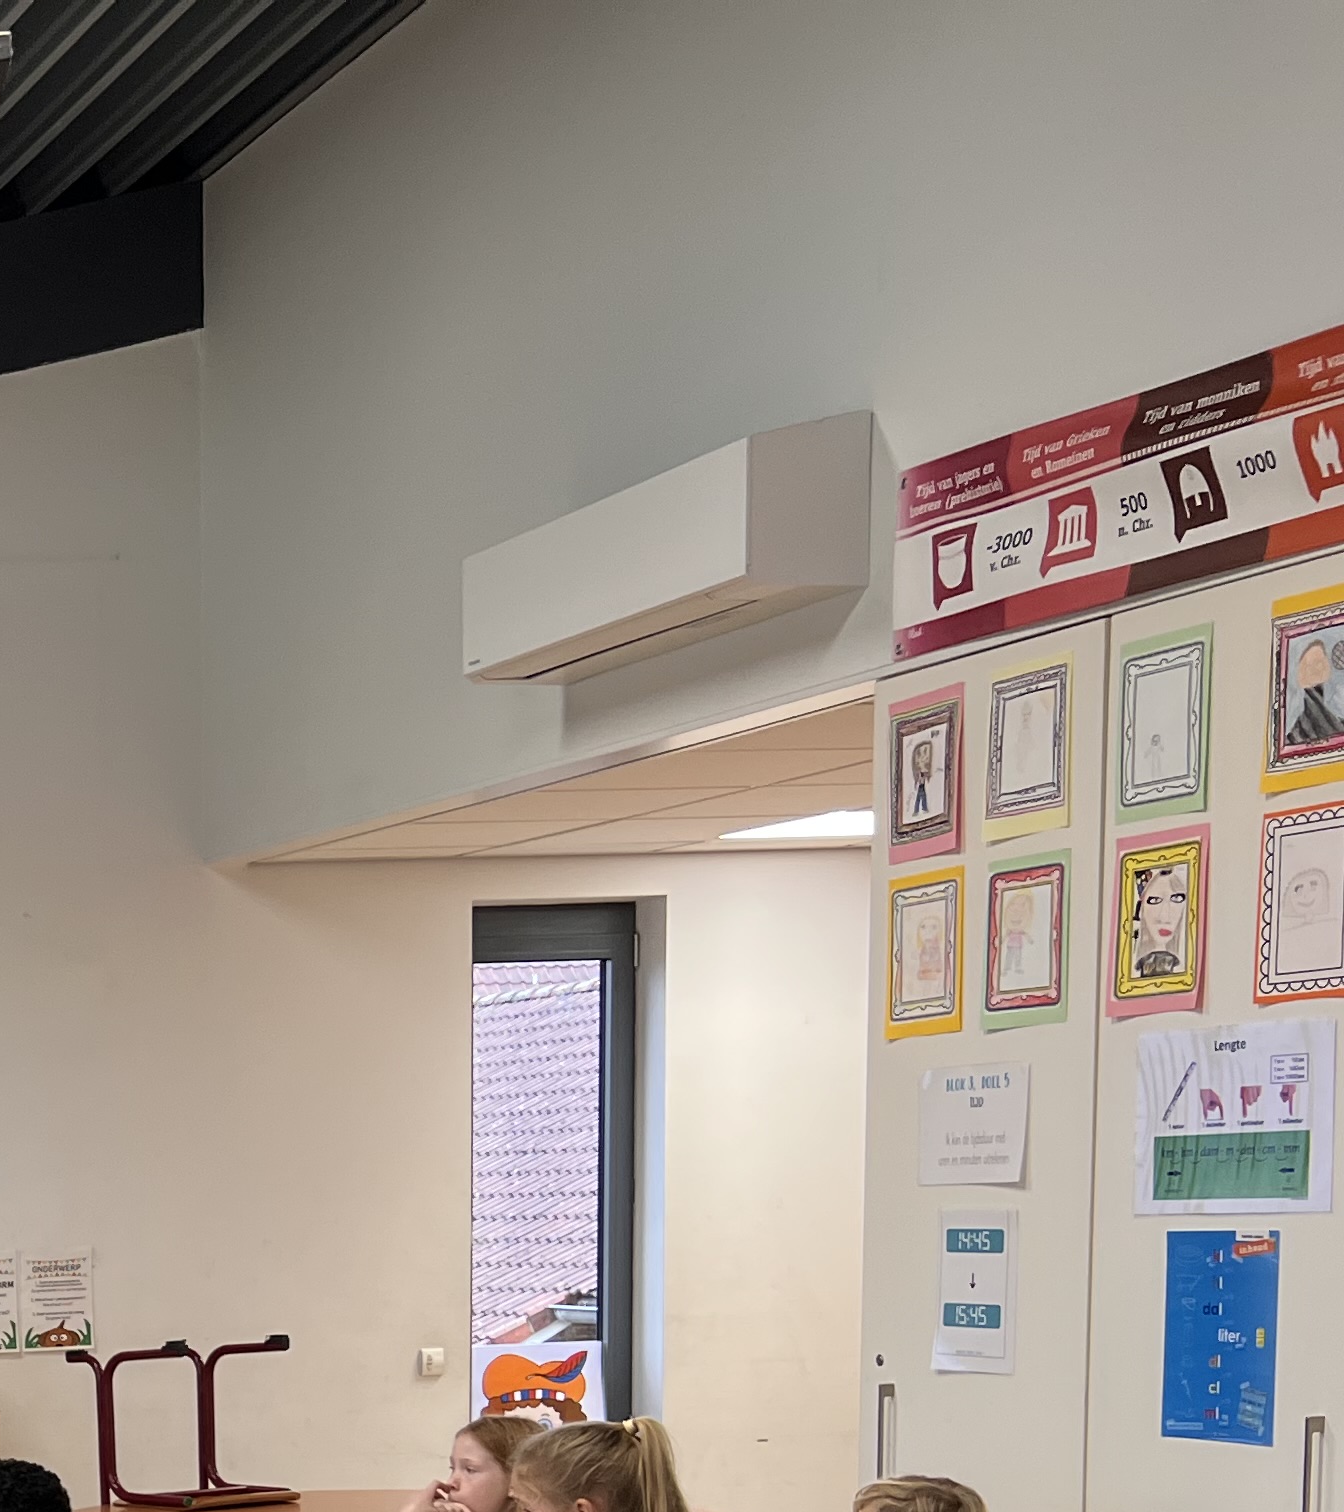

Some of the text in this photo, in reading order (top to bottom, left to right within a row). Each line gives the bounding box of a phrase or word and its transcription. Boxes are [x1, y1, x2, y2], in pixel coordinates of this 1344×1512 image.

[1297, 356, 1322, 379] Tijd
[1142, 380, 1260, 424] Tijd van monniken
[1158, 408, 1227, 435] en ridders
[1022, 424, 1111, 463] Tijd van Grieken
[1030, 447, 1095, 479] en Romeinen
[1235, 449, 1277, 479] 1000
[916, 462, 995, 500] Tijd van jagers en
[1119, 491, 1148, 517] 500
[1132, 517, 1154, 533] Chr.
[986, 527, 1033, 554] -3000
[1000, 554, 1021, 570] Chr.
[1213, 1039, 1247, 1053] Lengte
[946, 1078, 966, 1092] BLOK
[1004, 1072, 1010, 1088] 5
[958, 1231, 990, 1250] 14:45
[31, 1263, 82, 1273] ONDERWERP
[955, 1305, 987, 1326] 15:45
[1218, 1328, 1240, 1343] liter
